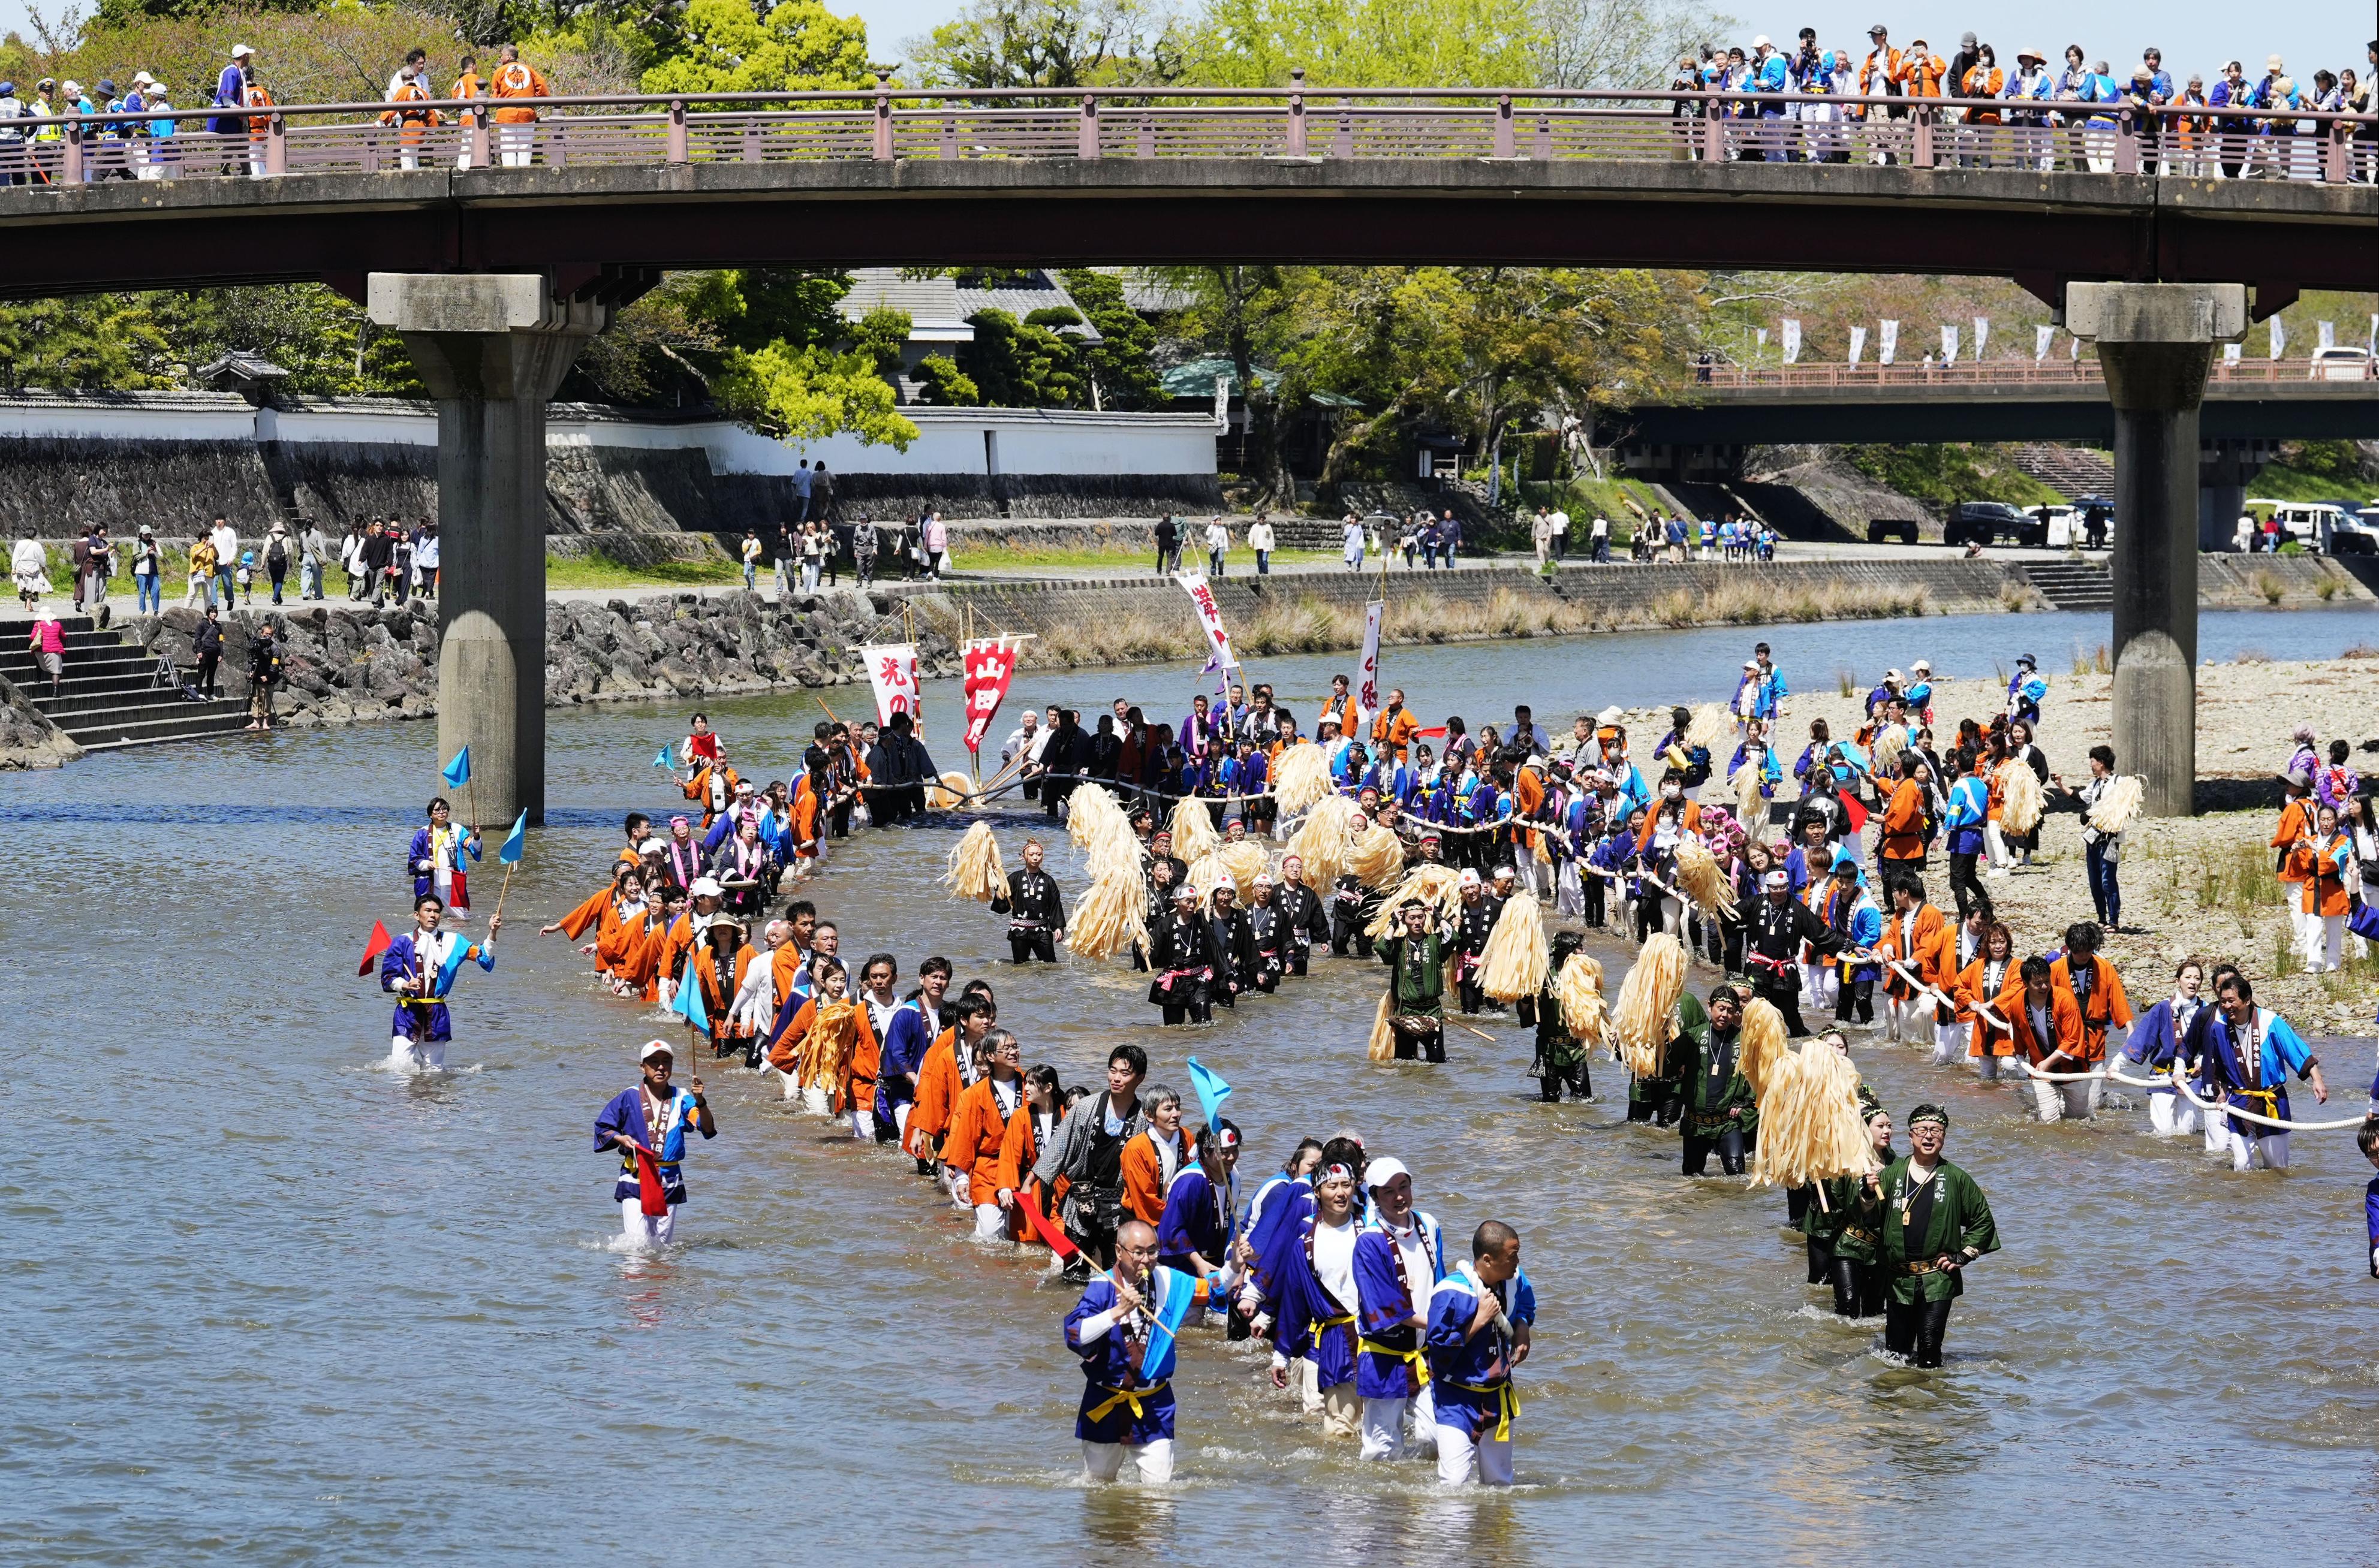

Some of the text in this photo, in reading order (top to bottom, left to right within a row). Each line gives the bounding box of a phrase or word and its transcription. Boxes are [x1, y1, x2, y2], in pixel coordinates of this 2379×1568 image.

[511, 65, 524, 90] 光の街
[880, 656, 908, 713] 光の
[714, 960, 722, 982] 光の街
[727, 957, 736, 979] 二見町
[1996, 968, 2005, 988] 二見町
[2069, 972, 2080, 994] 光の街
[868, 1008, 880, 1030] 光の街
[2025, 1005, 2035, 1027] 光の街
[1699, 1030, 1709, 1055] 光の街
[2229, 1027, 2244, 1063] 二見町
[2252, 1028, 2261, 1068] 溝口奉曳団
[956, 1054, 967, 1081] 光の街
[995, 1094, 1010, 1118] 光の街
[655, 1103, 670, 1153] 溝口奉曳団
[1892, 1178, 1902, 1209] 光の街
[1934, 1173, 1946, 1202] 二見町
[1387, 1236, 1407, 1284] 二見町
